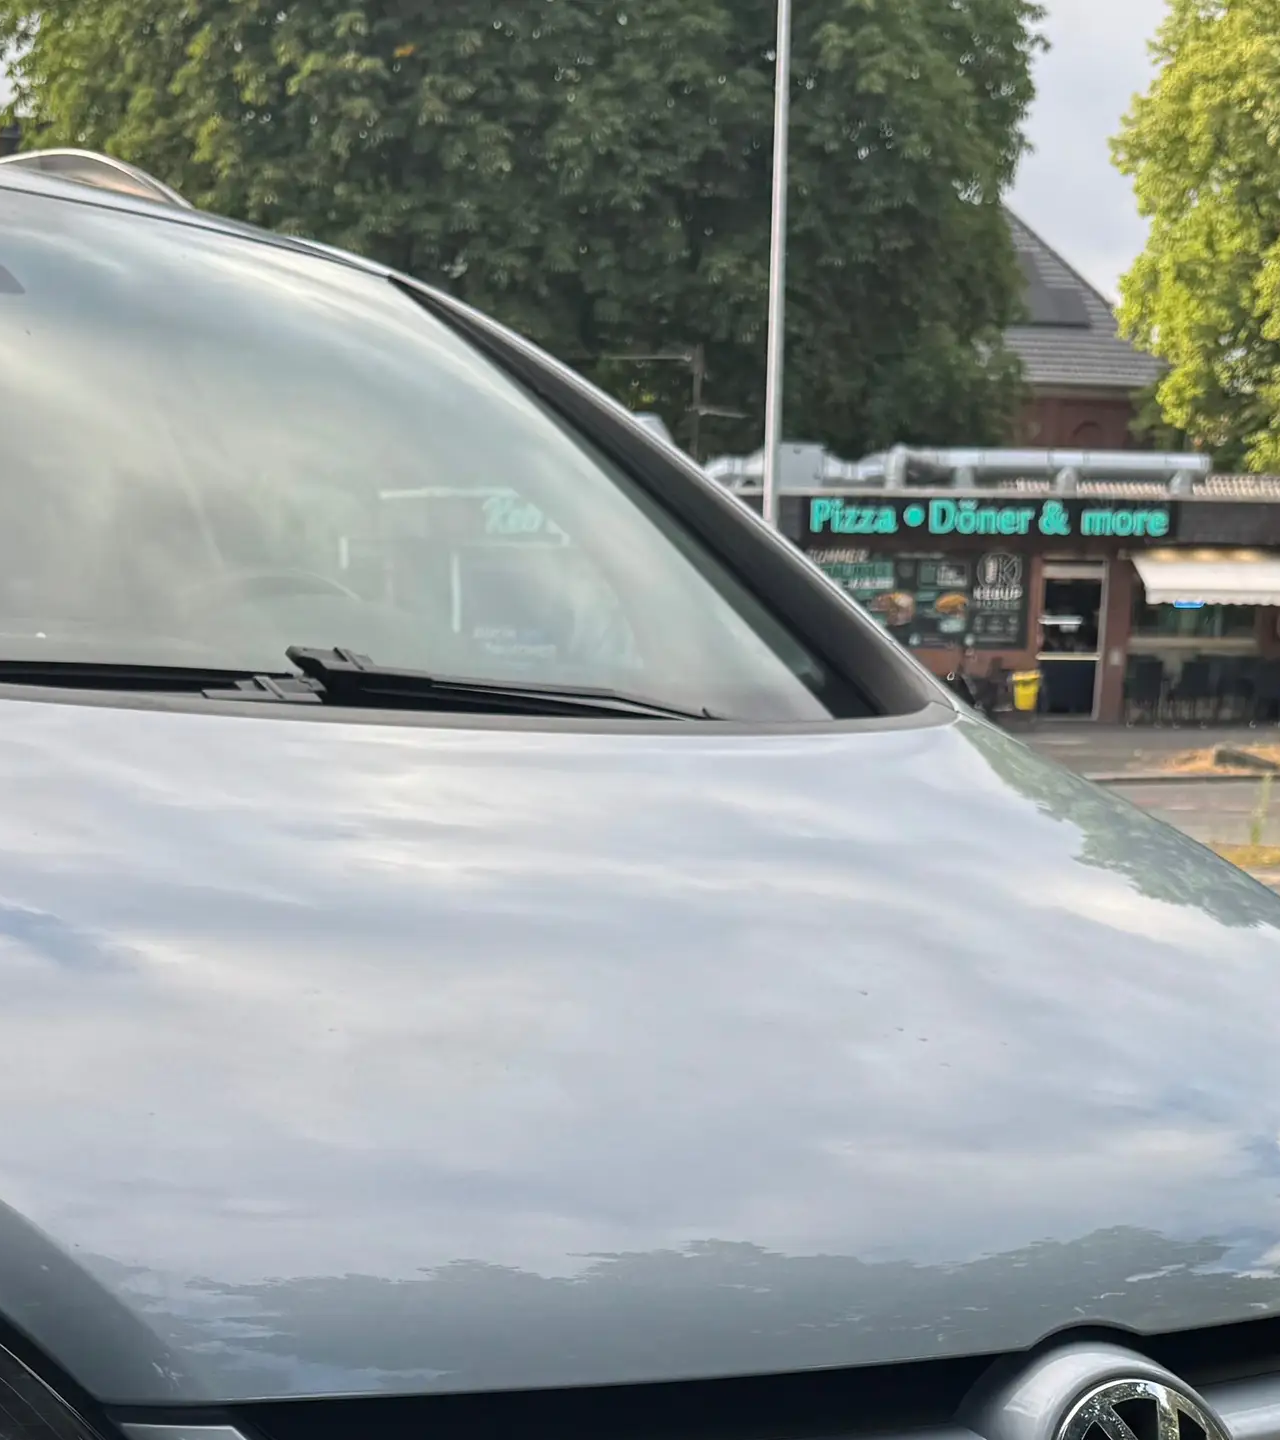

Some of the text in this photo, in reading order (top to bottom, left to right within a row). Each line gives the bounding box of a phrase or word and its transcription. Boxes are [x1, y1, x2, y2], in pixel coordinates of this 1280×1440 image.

[809, 496, 1170, 538] Pizza Döner & more
